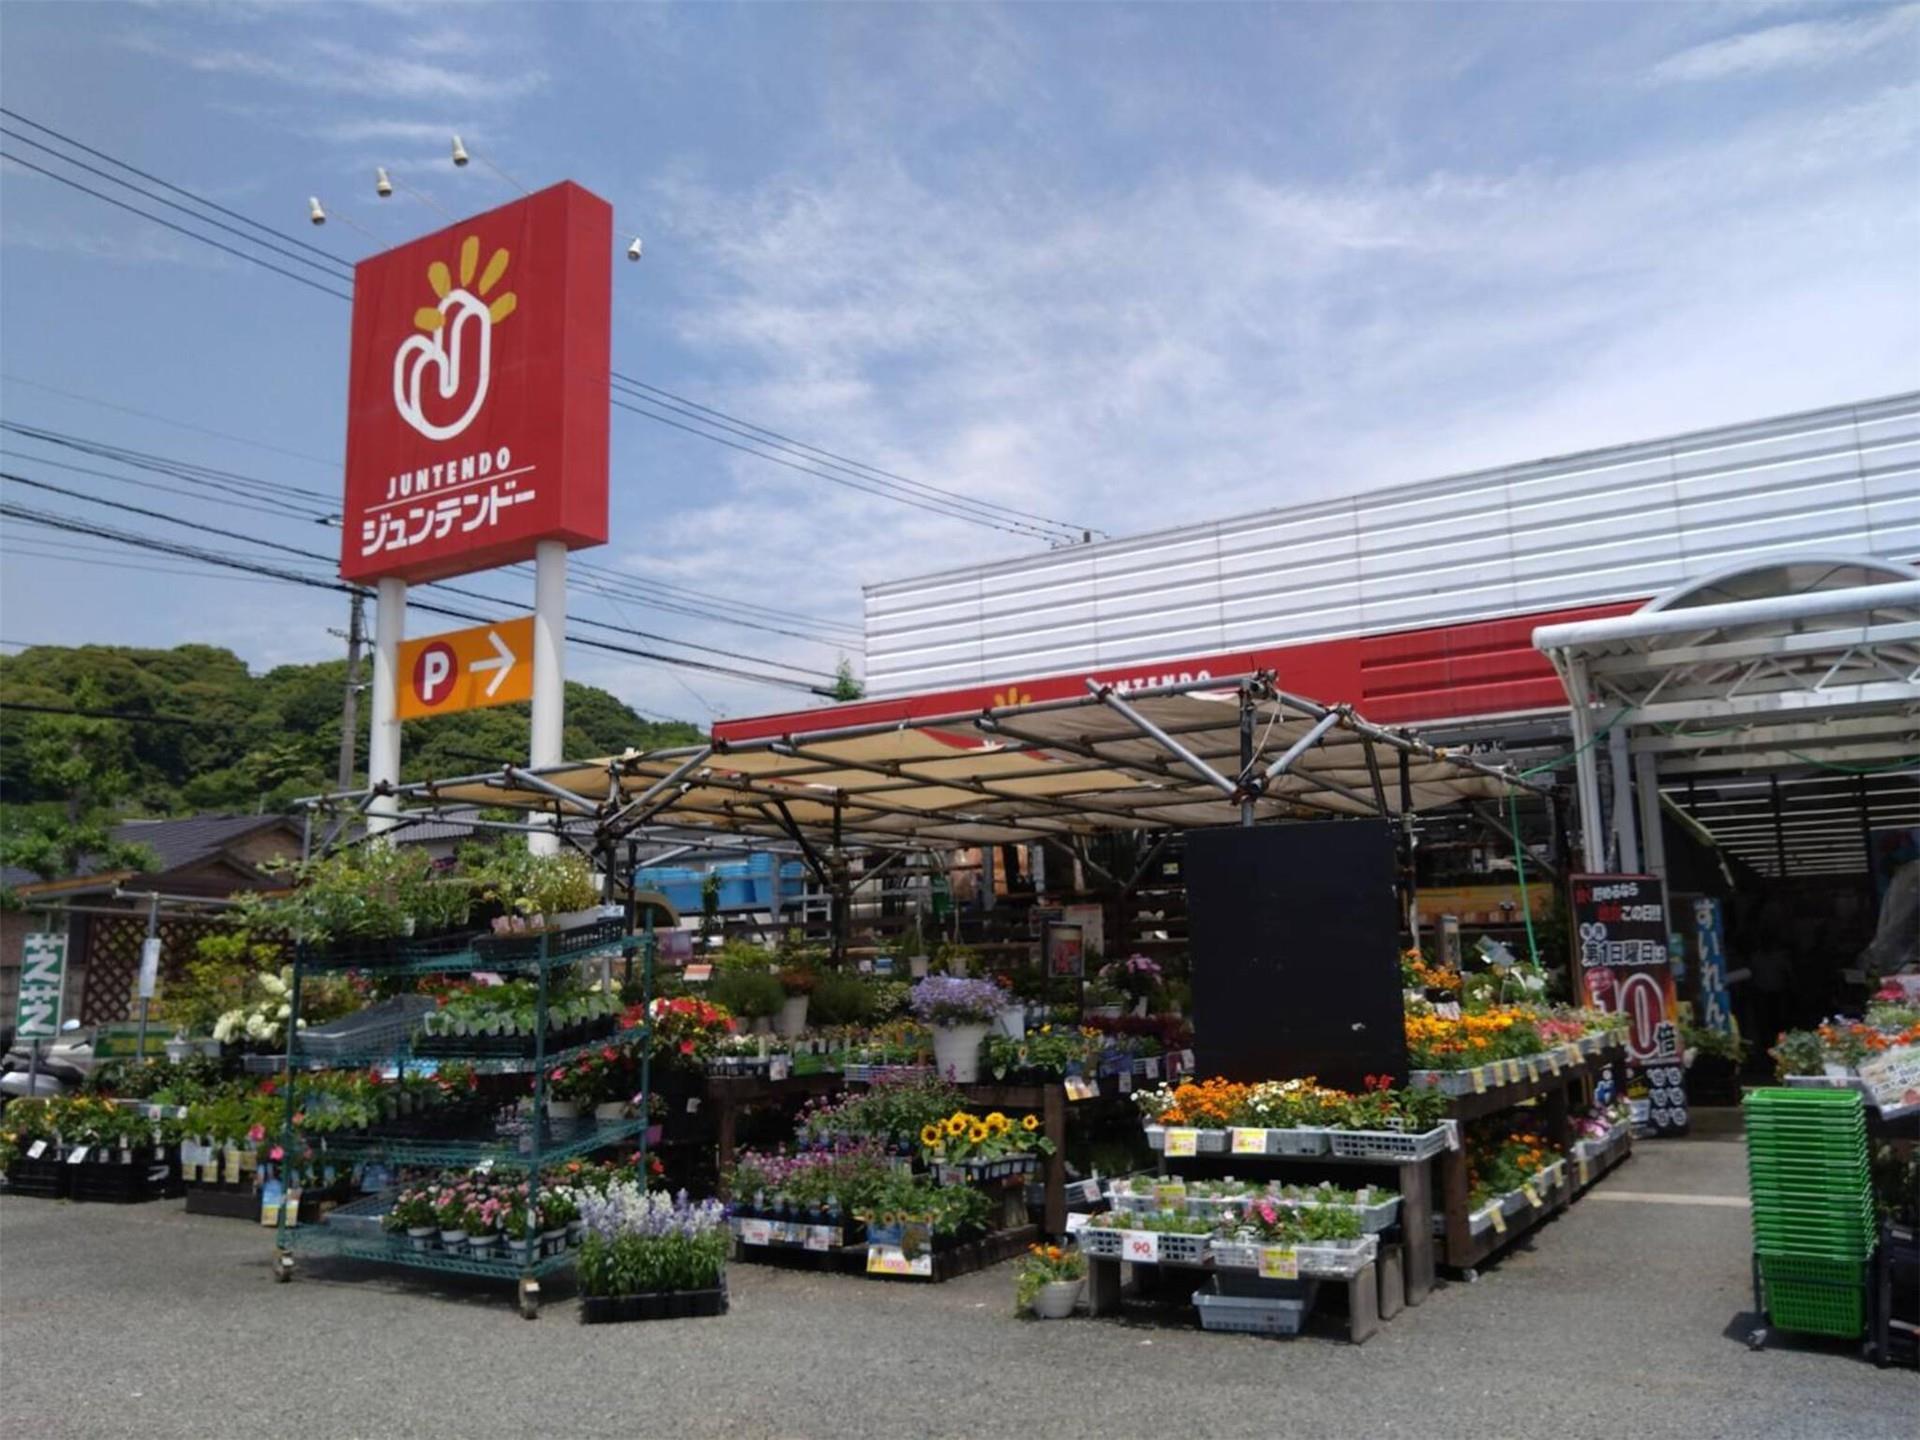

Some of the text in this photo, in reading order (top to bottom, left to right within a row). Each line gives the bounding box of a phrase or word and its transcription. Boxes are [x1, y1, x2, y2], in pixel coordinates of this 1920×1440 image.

[386, 447, 511, 500] JUNTENDO
[361, 481, 536, 557] ジュンテンドー
[422, 650, 450, 700] P
[1092, 669, 1212, 696] NTENDO
